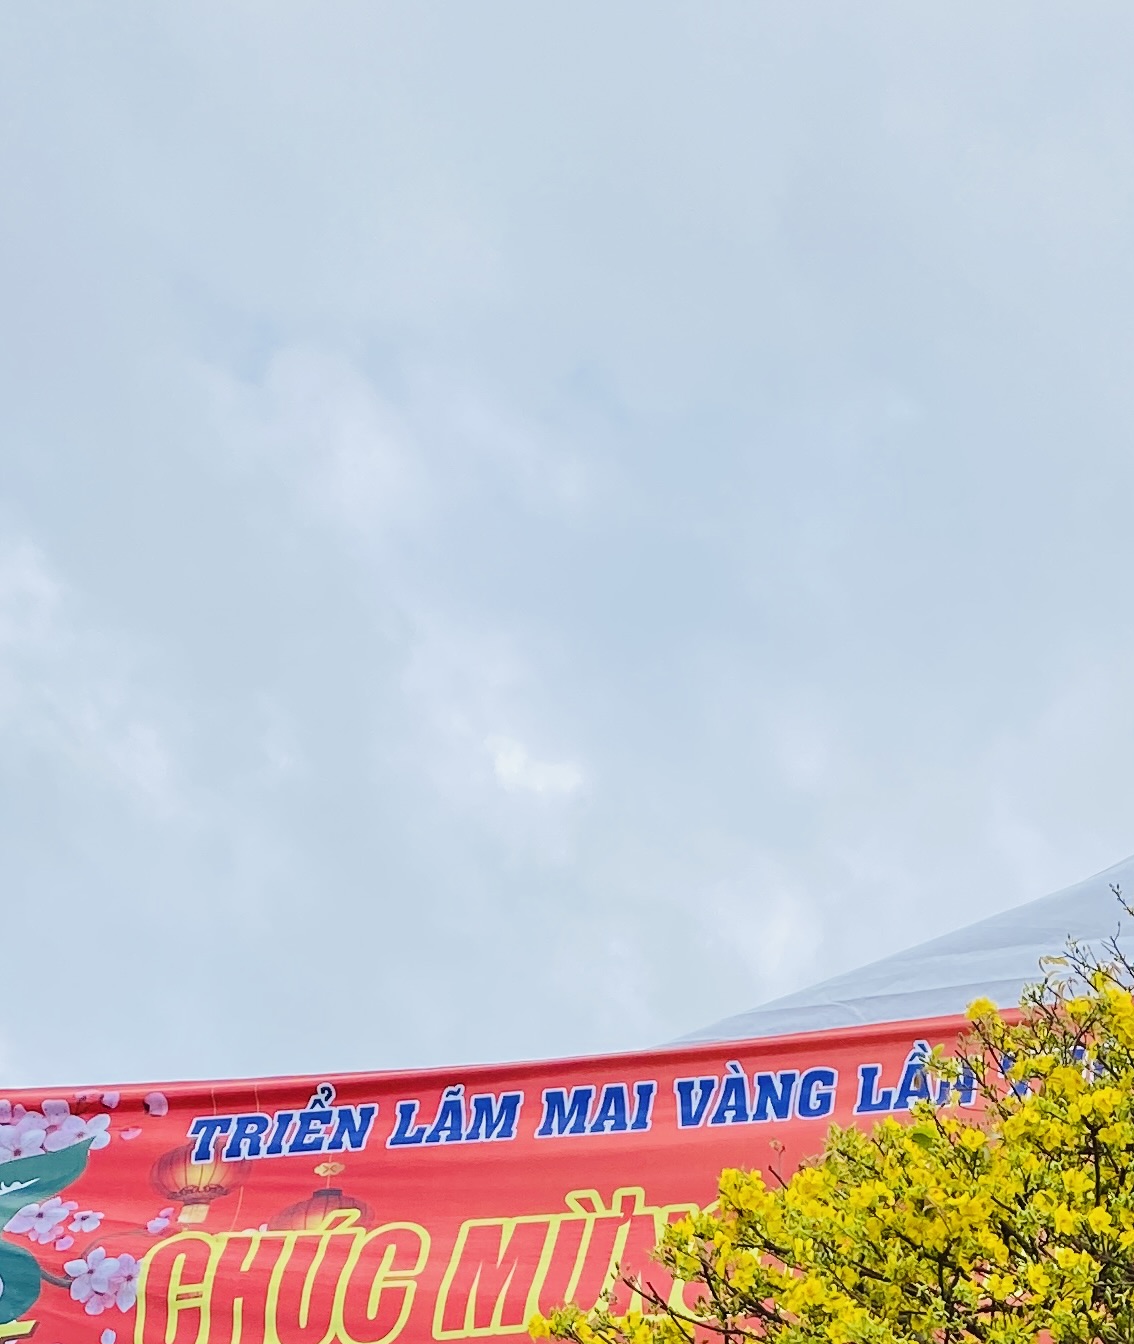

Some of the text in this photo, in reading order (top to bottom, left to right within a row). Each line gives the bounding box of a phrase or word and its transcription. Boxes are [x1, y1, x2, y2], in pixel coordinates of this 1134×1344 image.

[187, 1083, 379, 1164] TRIỂN
[385, 1084, 524, 1149] LÃM
[534, 1080, 658, 1139] MAI
[673, 1060, 838, 1129] VÀNG
[853, 1040, 978, 1115] LẦN
